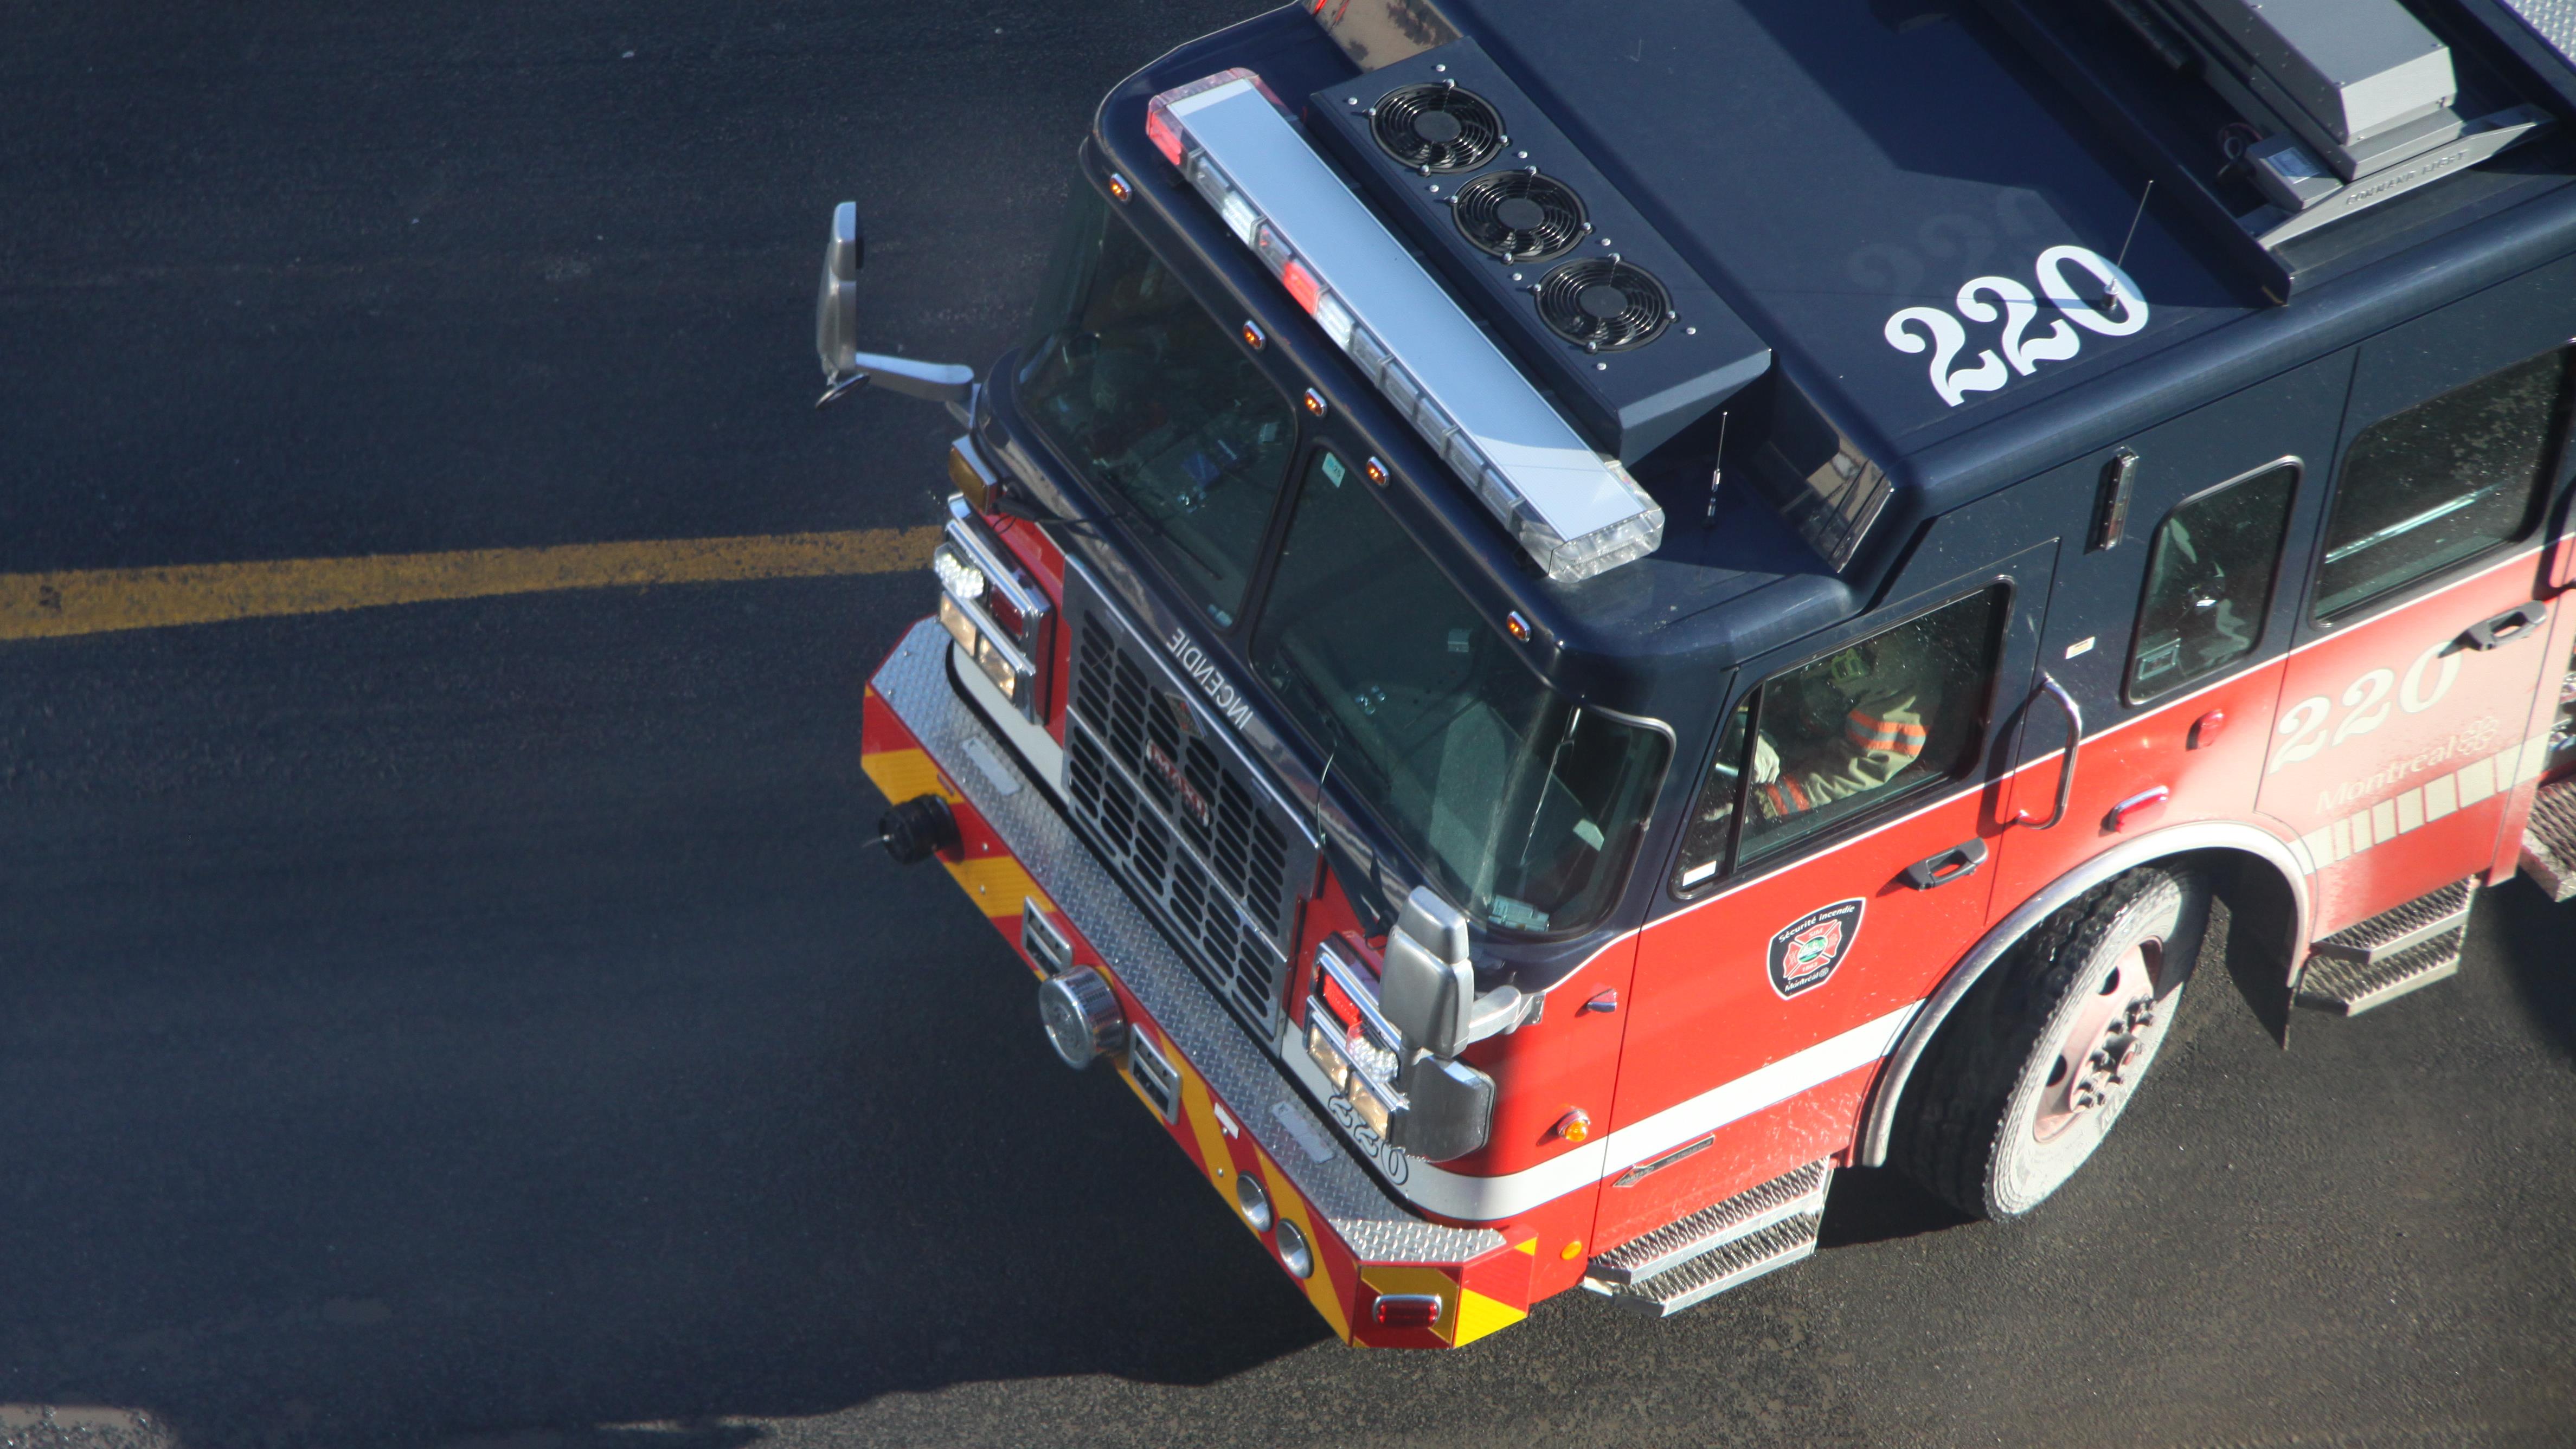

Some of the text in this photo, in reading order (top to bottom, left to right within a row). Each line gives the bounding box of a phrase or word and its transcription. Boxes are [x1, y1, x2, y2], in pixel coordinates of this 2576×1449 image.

[2346, 170, 2416, 205] COMMAND
[1884, 245, 2149, 407] 220
[2269, 640, 2463, 775] 220
[2315, 735, 2458, 815] Montréal
[1778, 905, 1855, 943] Sécurité incendie
